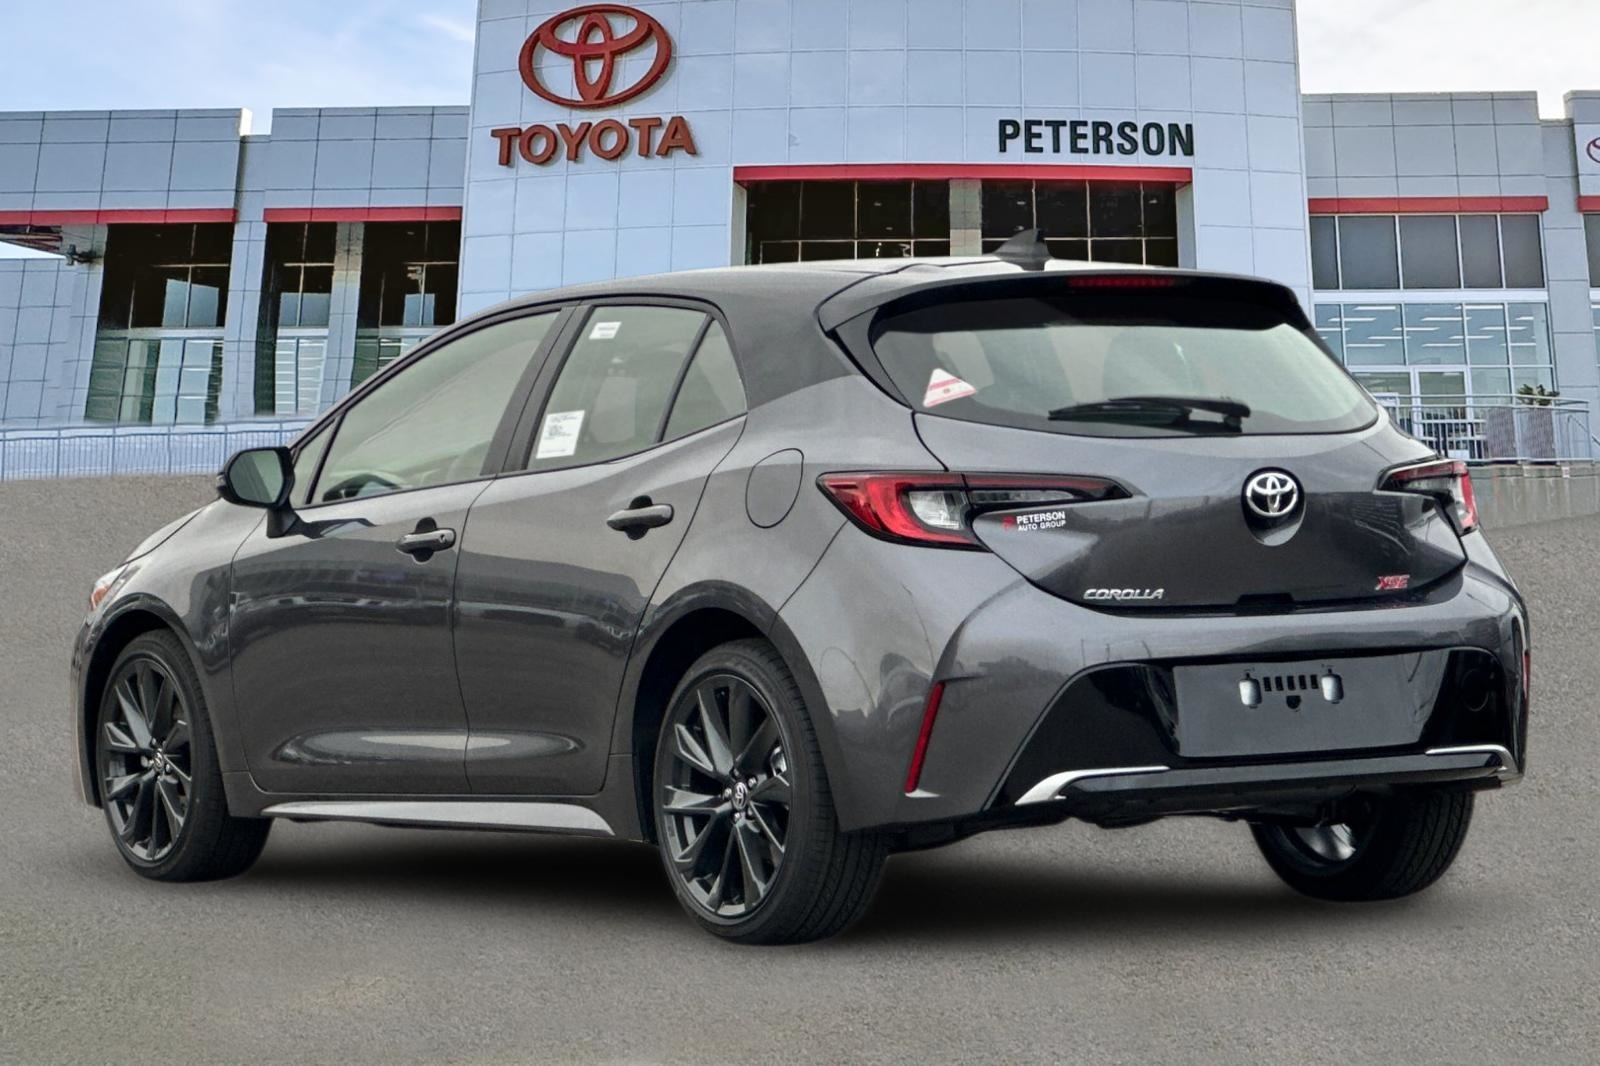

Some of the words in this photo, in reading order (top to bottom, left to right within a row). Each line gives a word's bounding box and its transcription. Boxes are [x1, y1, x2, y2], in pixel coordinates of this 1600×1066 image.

[490, 115, 697, 166] TOYOTA
[998, 119, 1194, 156] PETERSON
[1016, 511, 1066, 524] PETERSON
[1018, 523, 1038, 531] AUTO
[1040, 519, 1066, 529] GROUP
[1375, 574, 1410, 590] XSE
[1083, 588, 1165, 601] COROLLA
